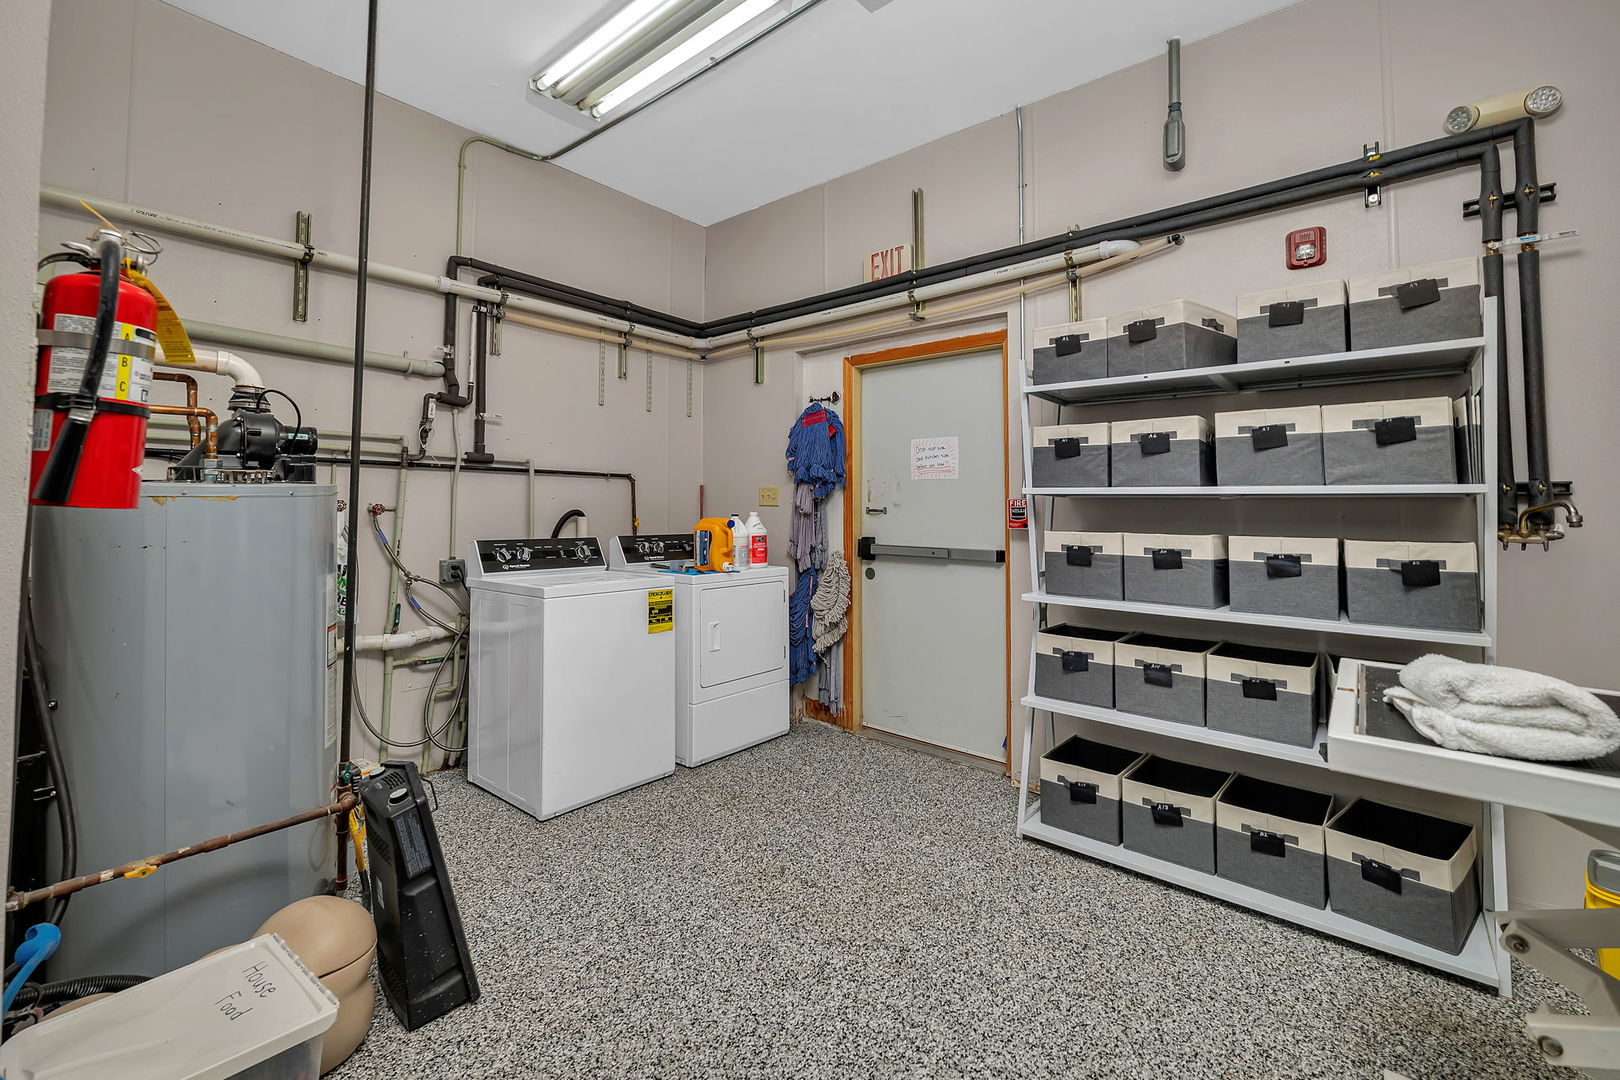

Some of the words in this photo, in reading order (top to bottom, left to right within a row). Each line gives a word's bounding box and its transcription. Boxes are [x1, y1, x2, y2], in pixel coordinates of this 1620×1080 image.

[871, 245, 904, 281] EXIT
[122, 357, 128, 367] B
[119, 381, 126, 391] C
[1010, 499, 1027, 507] FIRE
[242, 960, 277, 998] House
[215, 991, 254, 1021] Food
